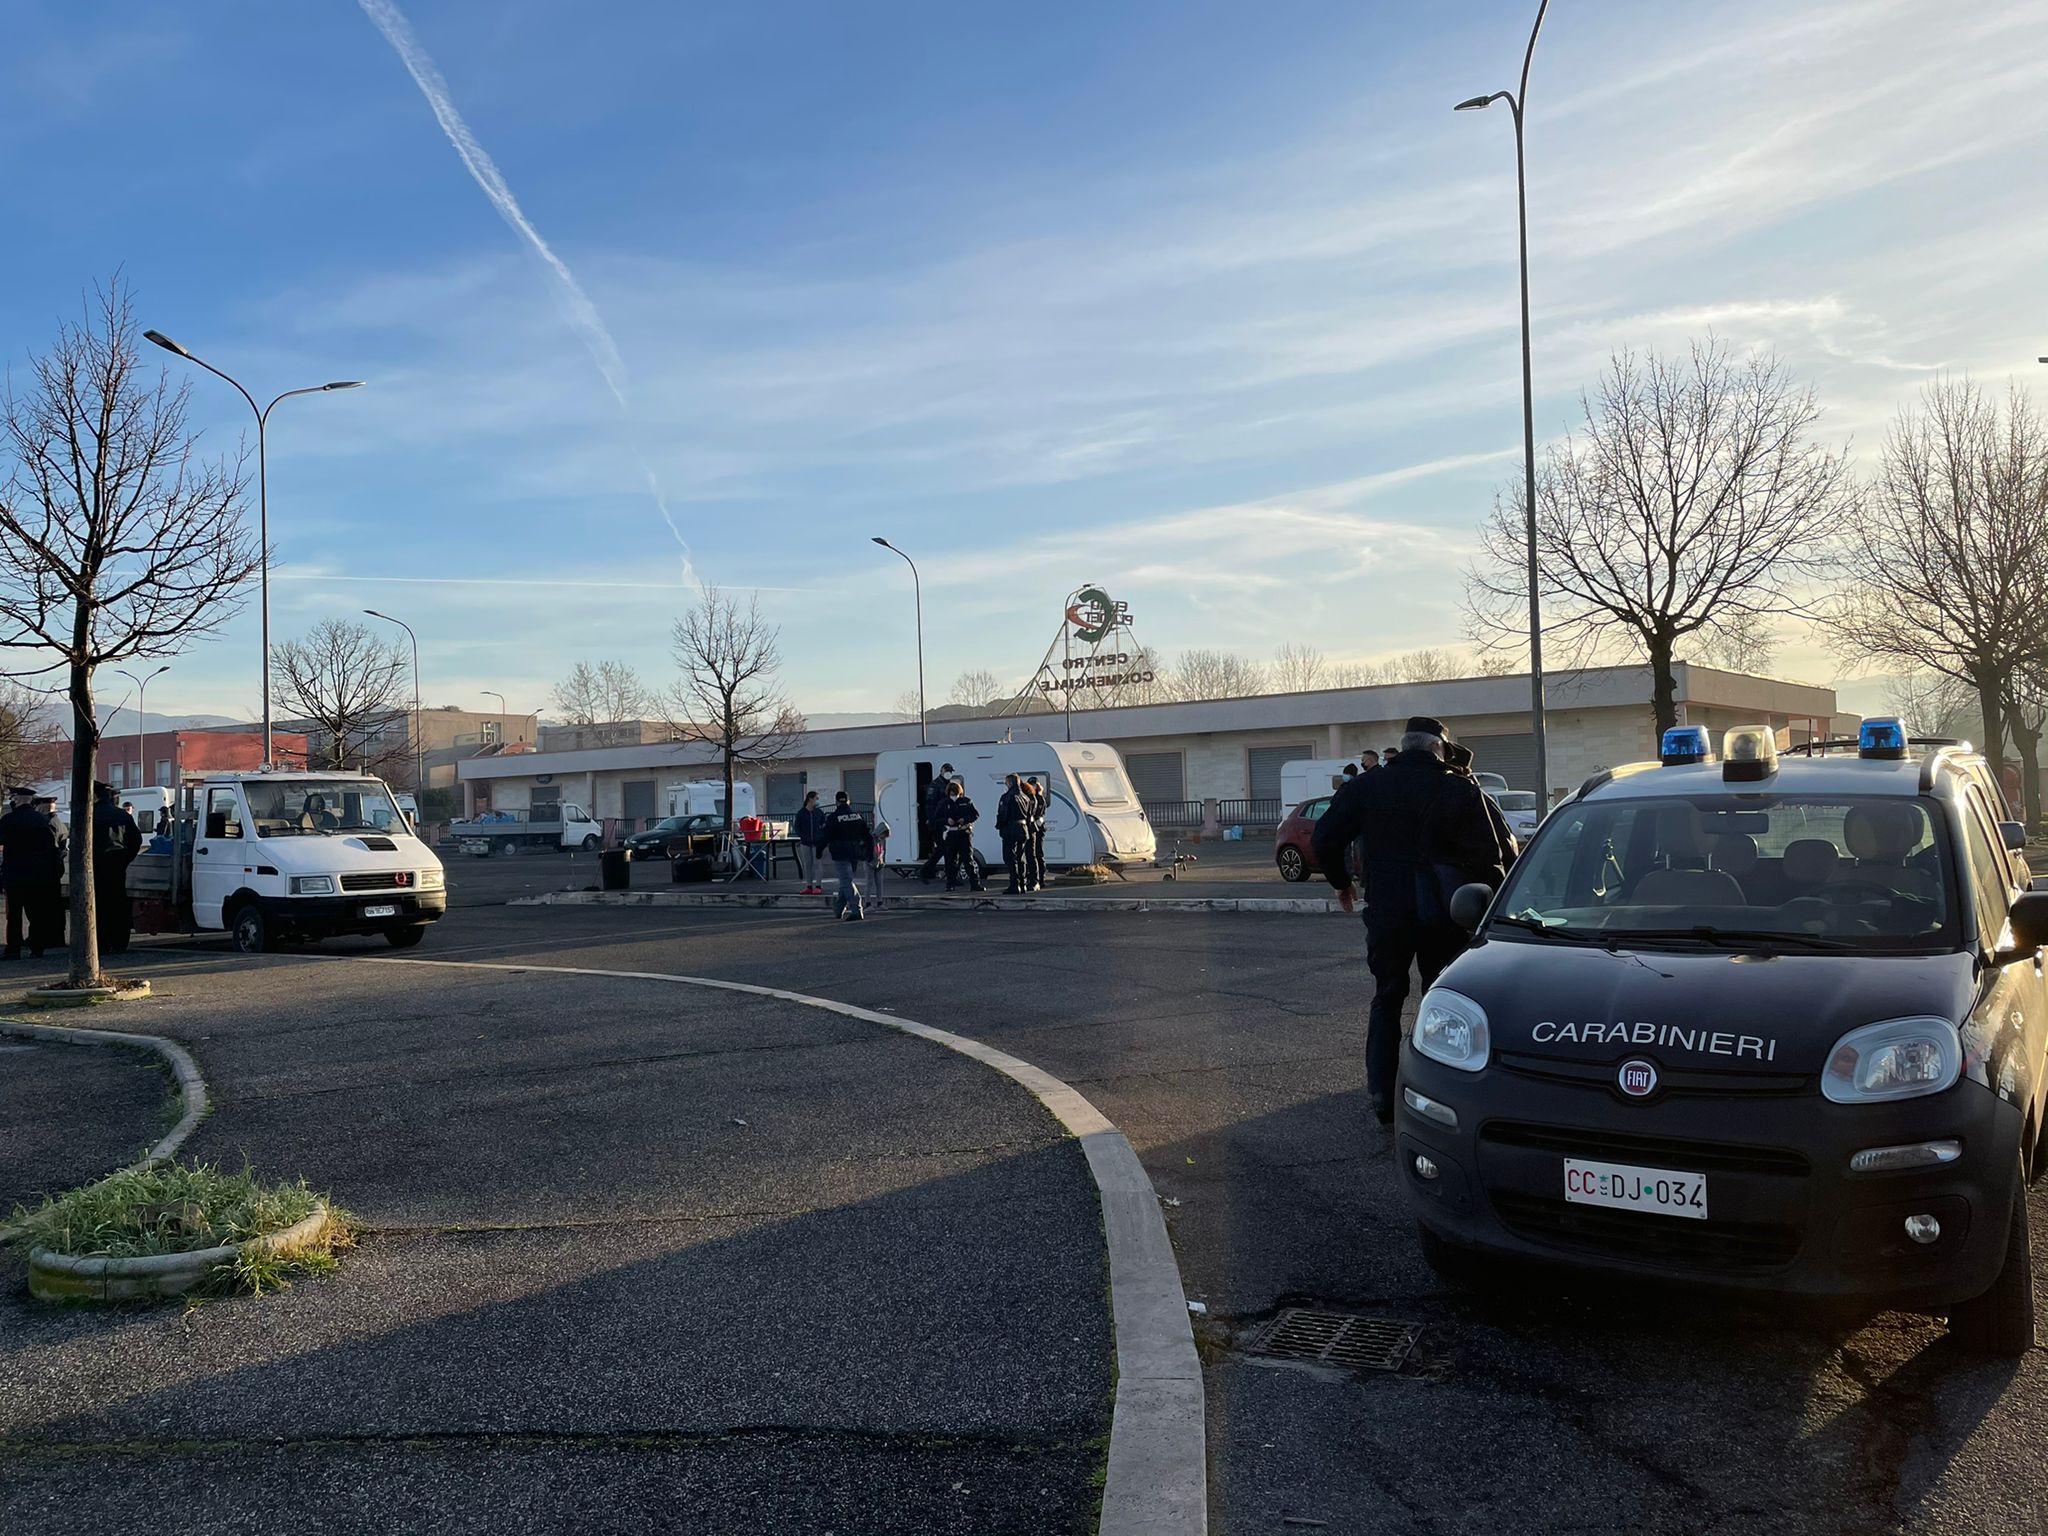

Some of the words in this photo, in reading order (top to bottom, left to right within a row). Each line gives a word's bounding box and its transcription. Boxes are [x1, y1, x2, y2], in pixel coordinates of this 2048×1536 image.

[1531, 1022, 1777, 1061] CARABINIERI
[1627, 1070, 1649, 1087] FIAT
[1567, 1169, 1596, 1195] CC
[1611, 1174, 1641, 1201] DJ
[1656, 1180, 1703, 1209] 034
